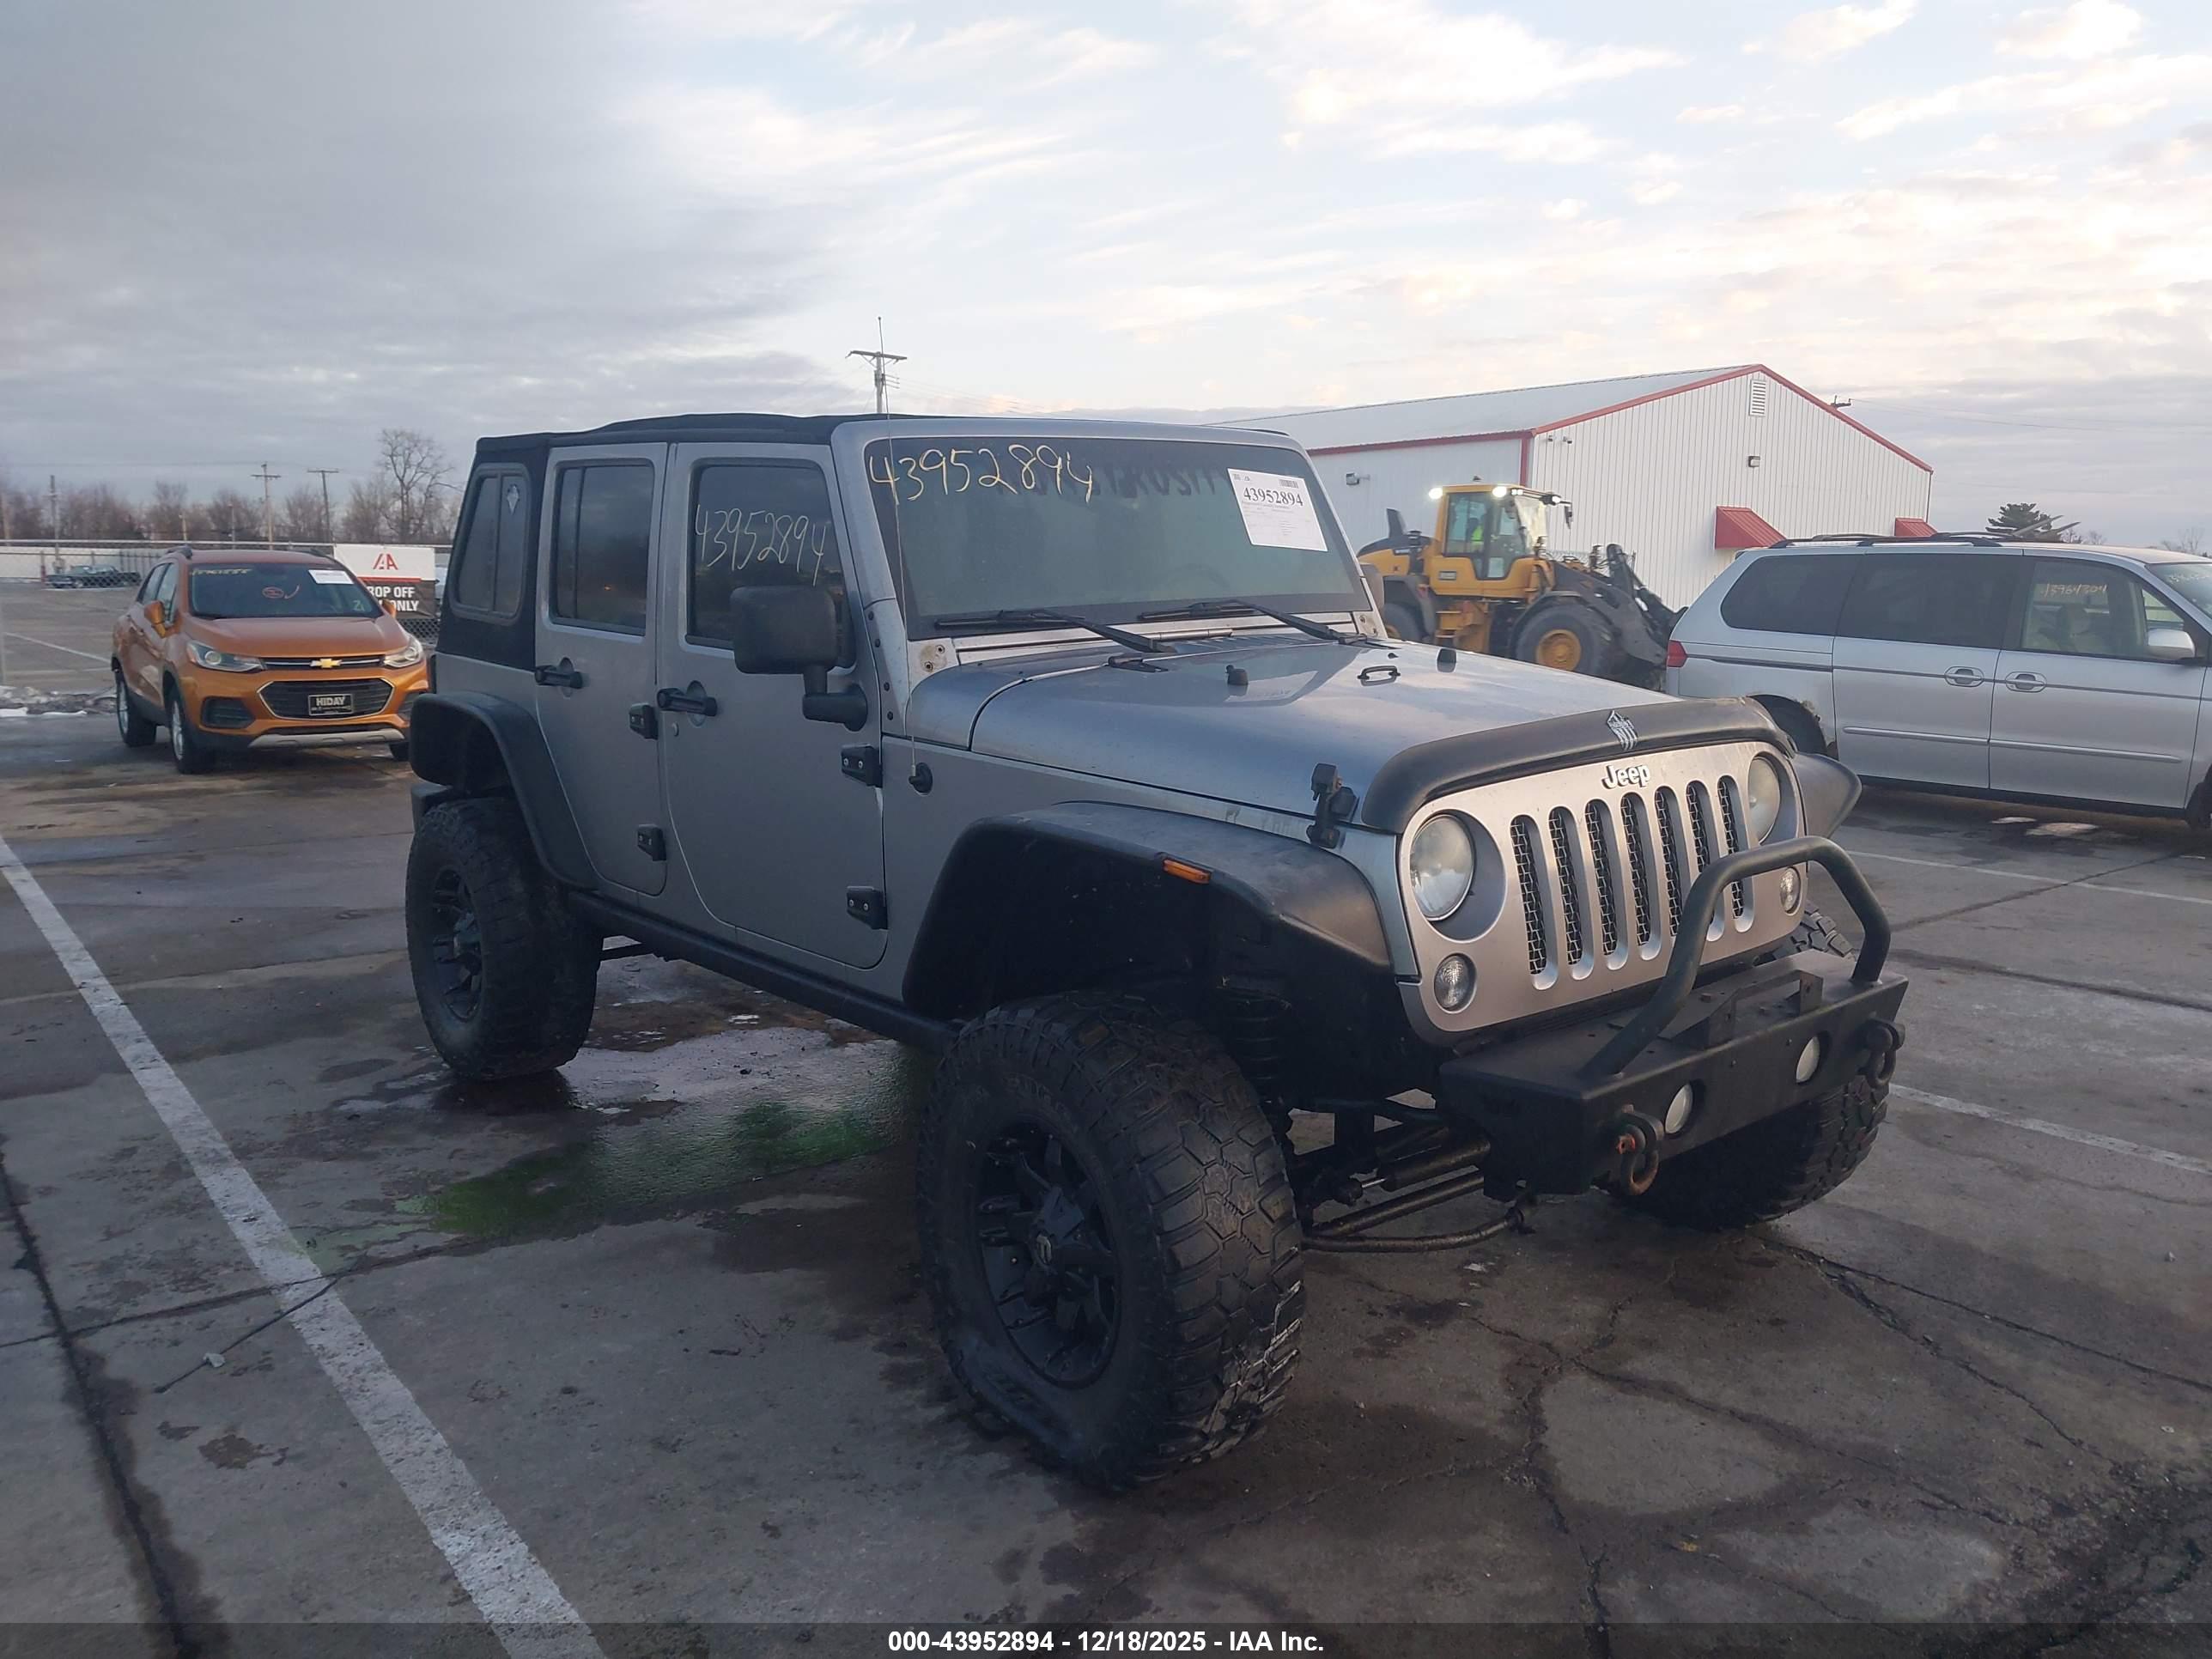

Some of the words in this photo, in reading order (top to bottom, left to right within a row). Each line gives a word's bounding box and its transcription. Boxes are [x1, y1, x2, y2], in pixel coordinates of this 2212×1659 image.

[870, 444, 1092, 505] 43952894
[1243, 487, 1304, 507] 43952894
[696, 504, 826, 586] 43952894
[367, 586, 392, 598] ROP
[393, 586, 416, 598] OFF
[1601, 764, 1650, 789] Jeep
